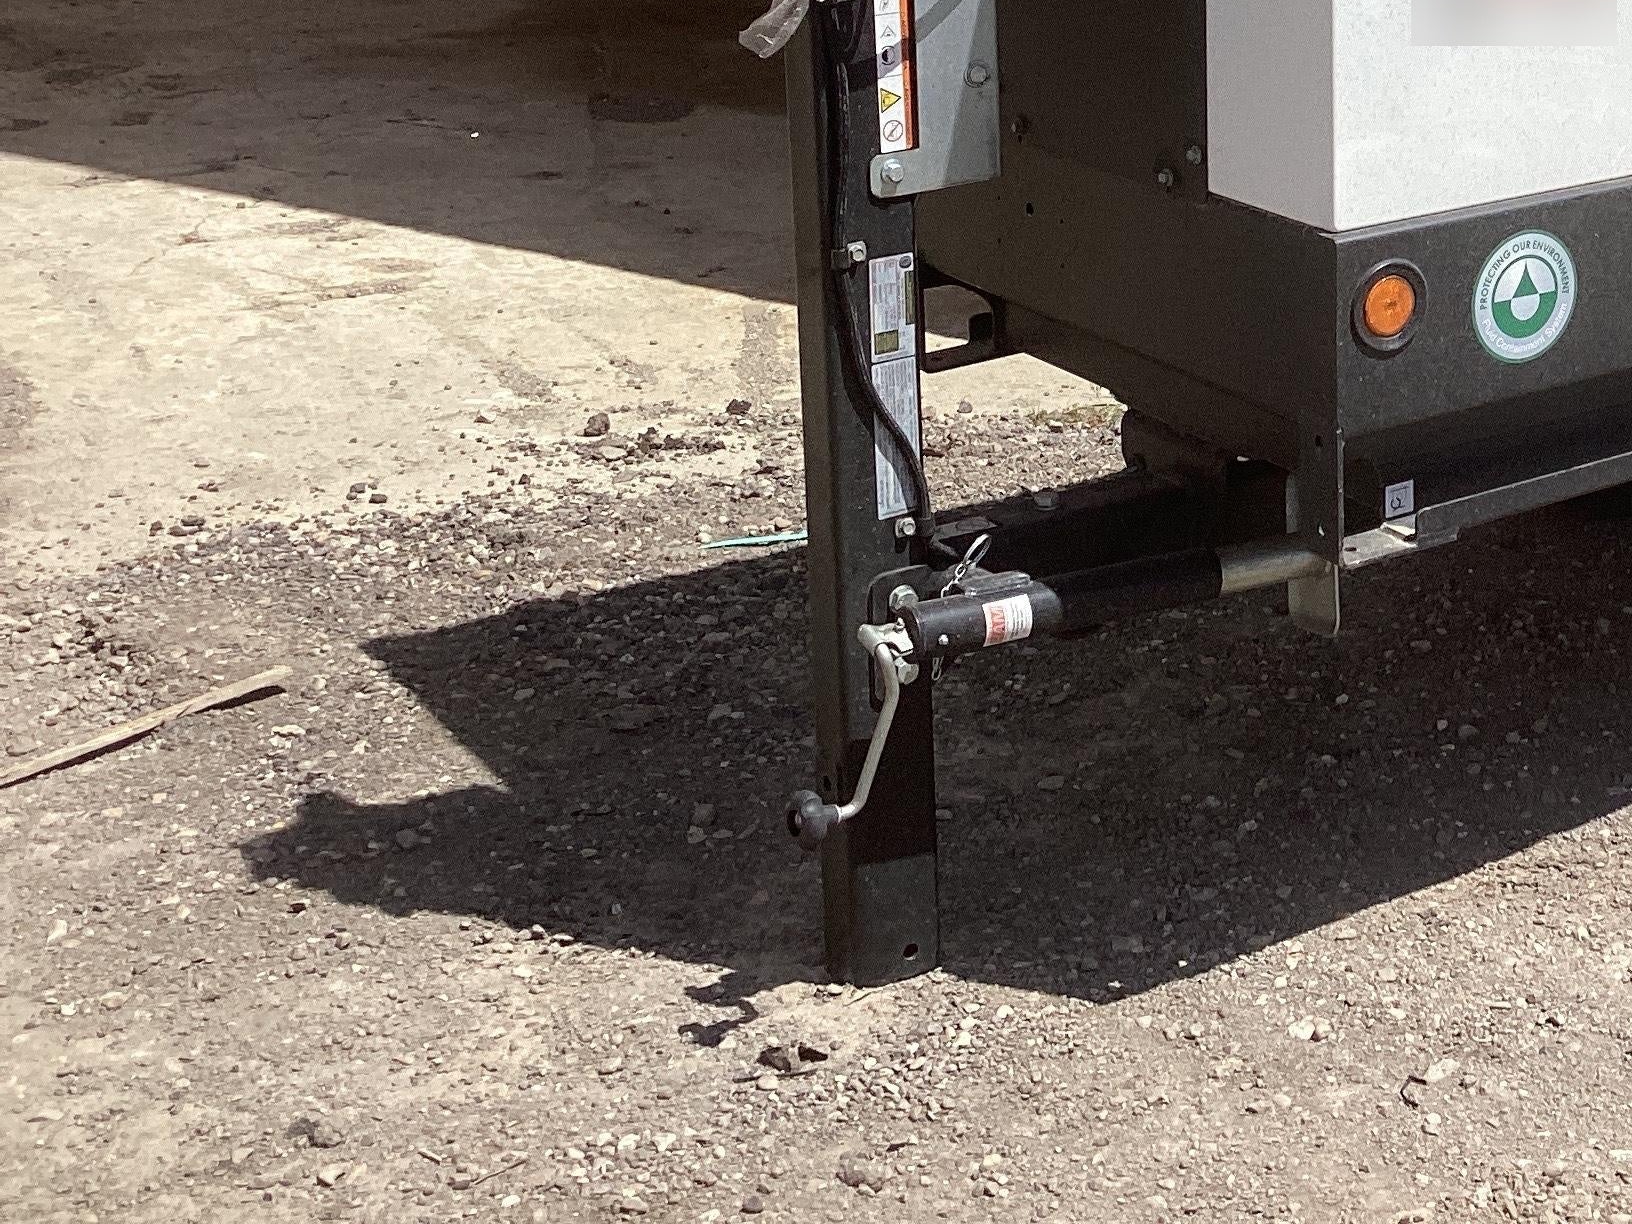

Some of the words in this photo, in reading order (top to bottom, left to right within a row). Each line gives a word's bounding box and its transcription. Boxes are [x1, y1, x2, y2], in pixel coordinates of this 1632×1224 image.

[1479, 250, 1511, 311] PROTECTING
[1512, 240, 1531, 253] OUR
[1532, 240, 1570, 295] ENVIRONMENT
